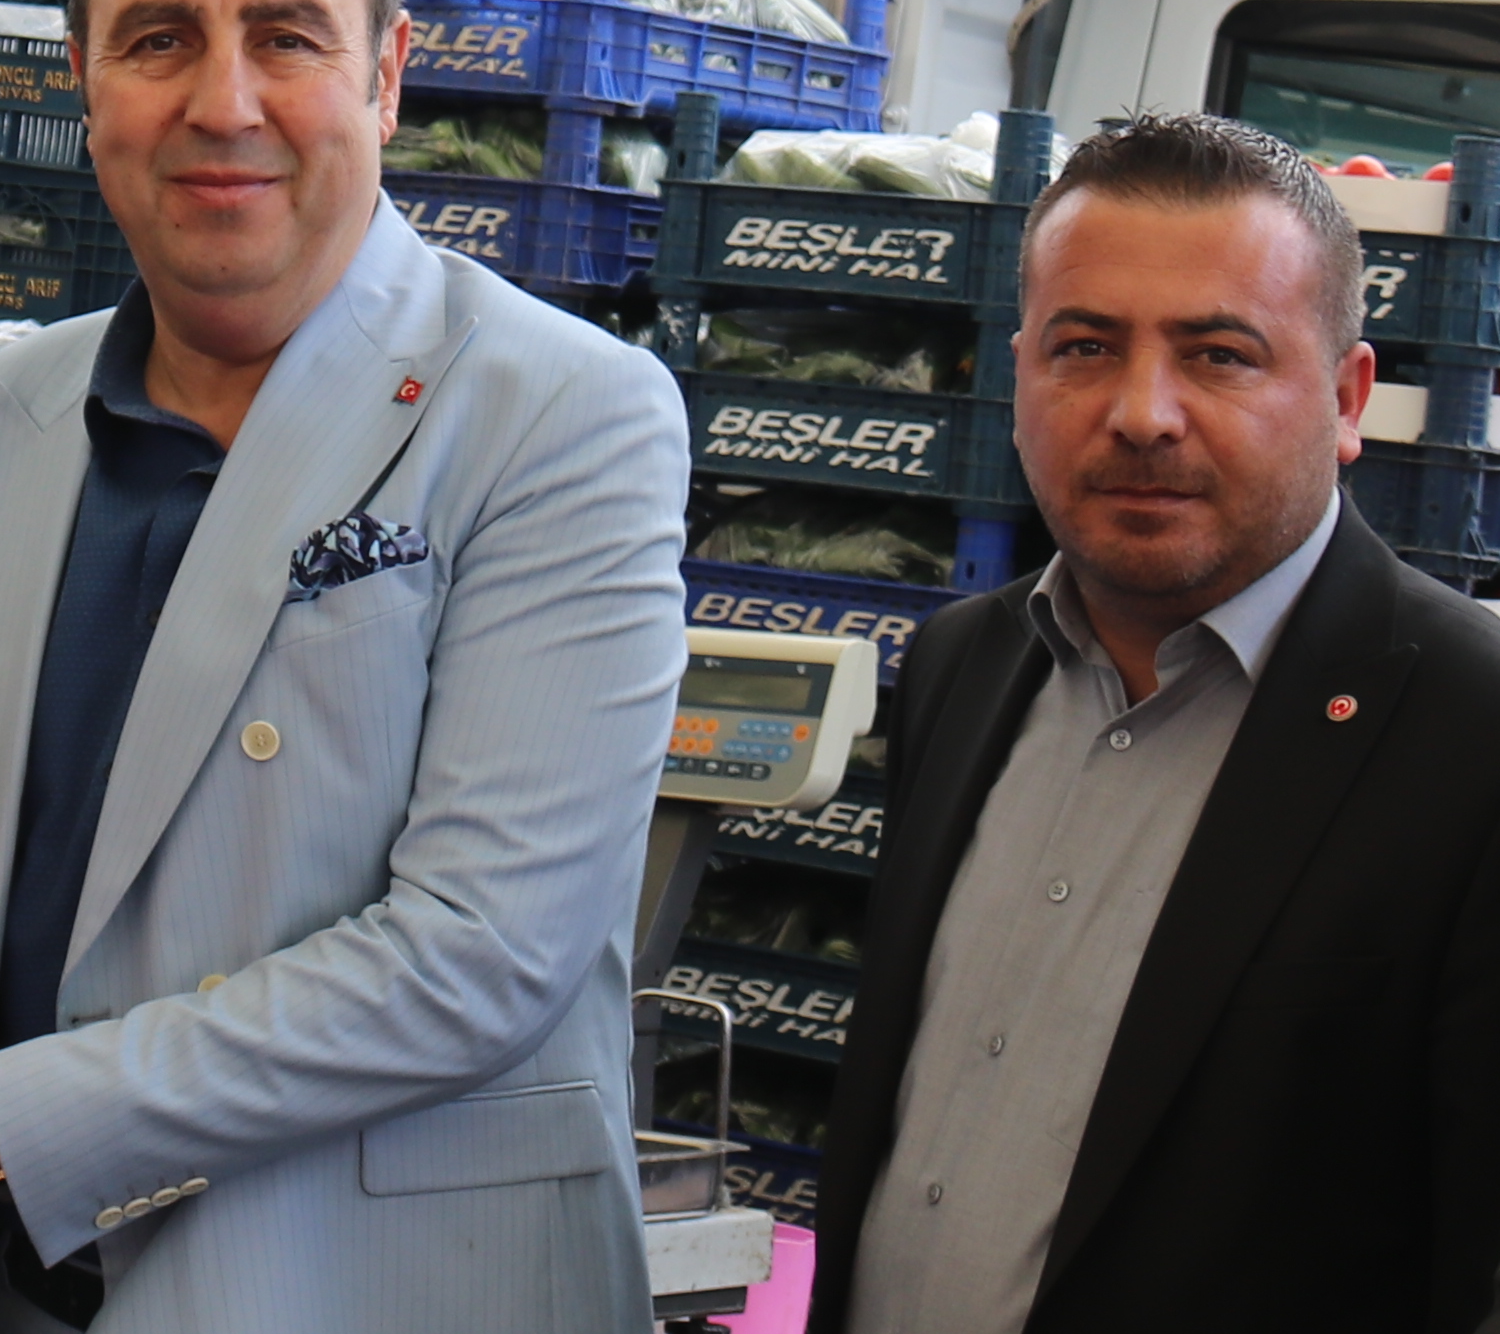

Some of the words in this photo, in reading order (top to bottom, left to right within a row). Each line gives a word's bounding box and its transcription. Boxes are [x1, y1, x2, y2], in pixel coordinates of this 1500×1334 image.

[725, 216, 955, 262] BEŞLER
[847, 258, 949, 283] HAL
[707, 406, 936, 455] BEŞLER
[829, 450, 934, 478] HAL
[777, 1018, 847, 1046] HA
